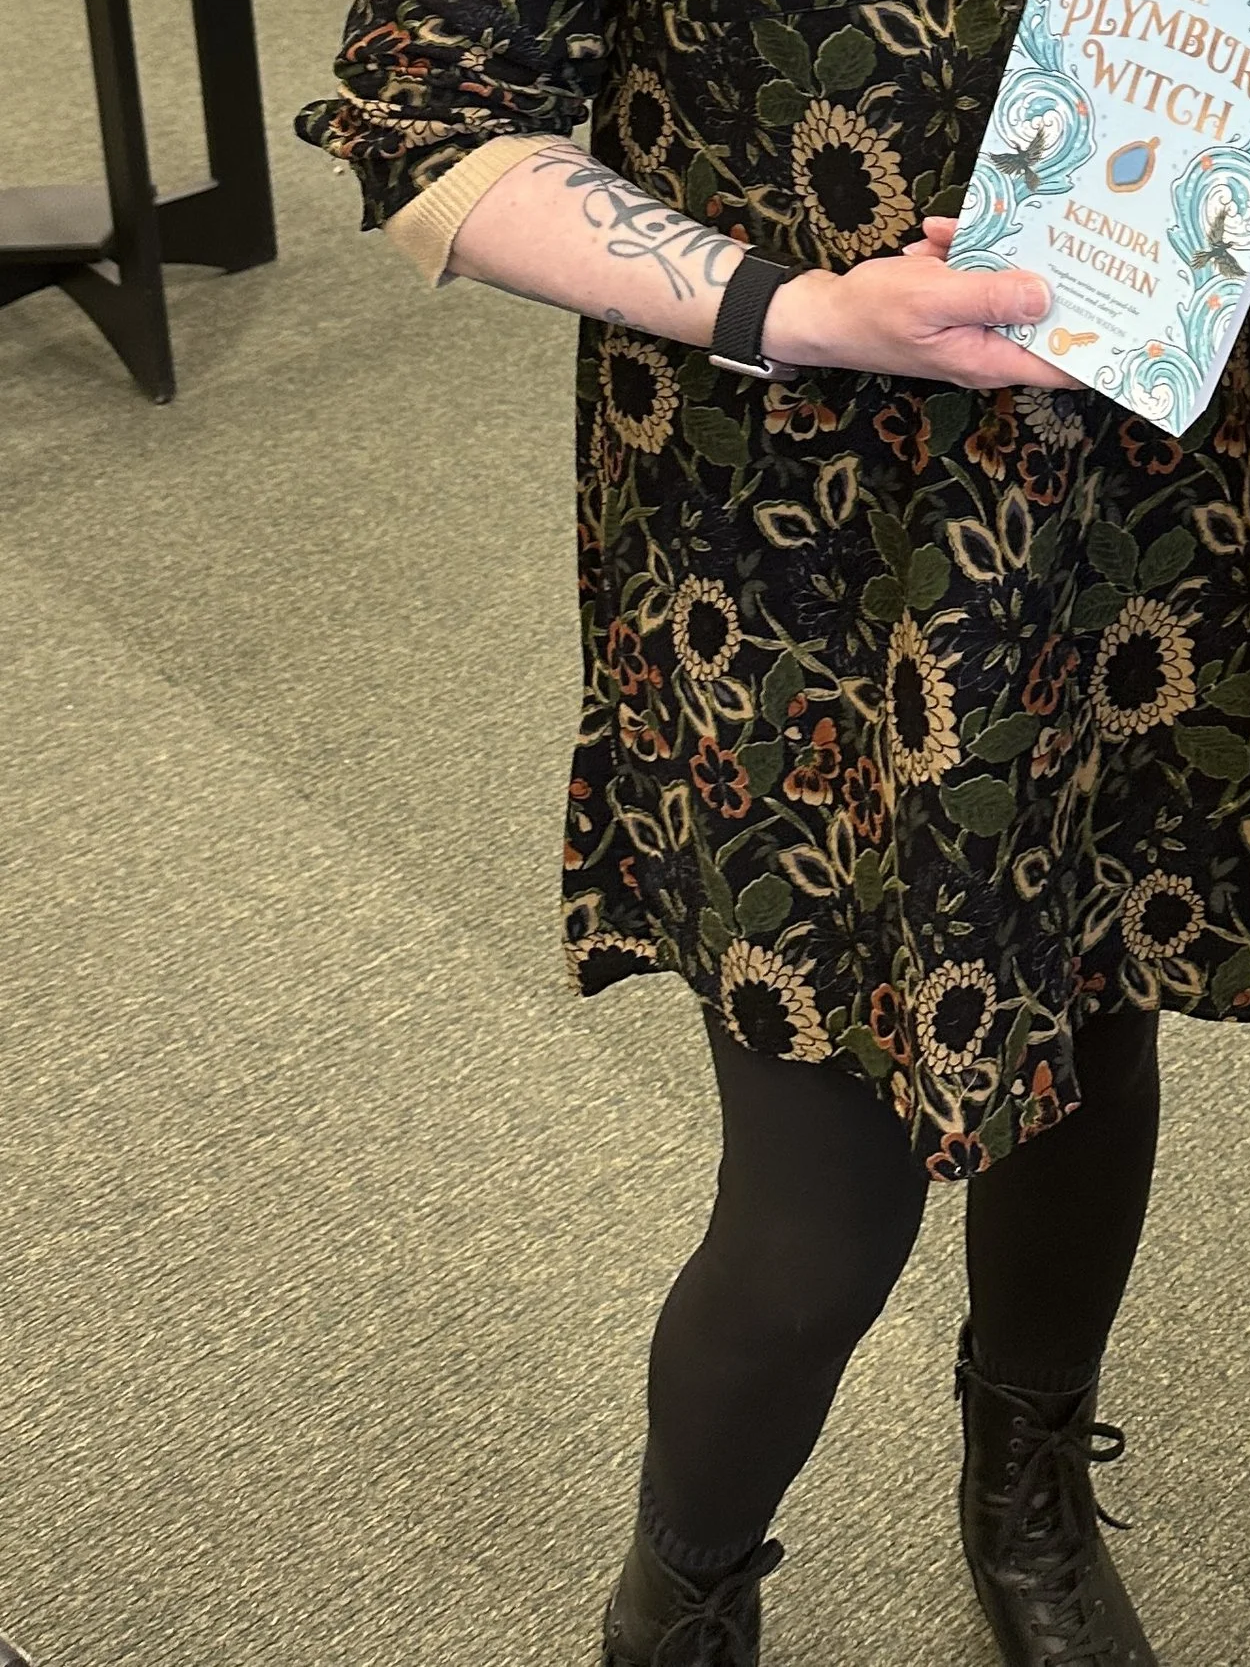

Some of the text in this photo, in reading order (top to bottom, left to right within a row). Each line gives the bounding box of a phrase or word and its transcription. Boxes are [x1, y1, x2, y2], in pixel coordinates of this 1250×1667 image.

[1082, 38, 1235, 142] WITCH
[1047, 224, 1161, 298] VAUGHAN
[1063, 198, 1161, 264] KENDRA
